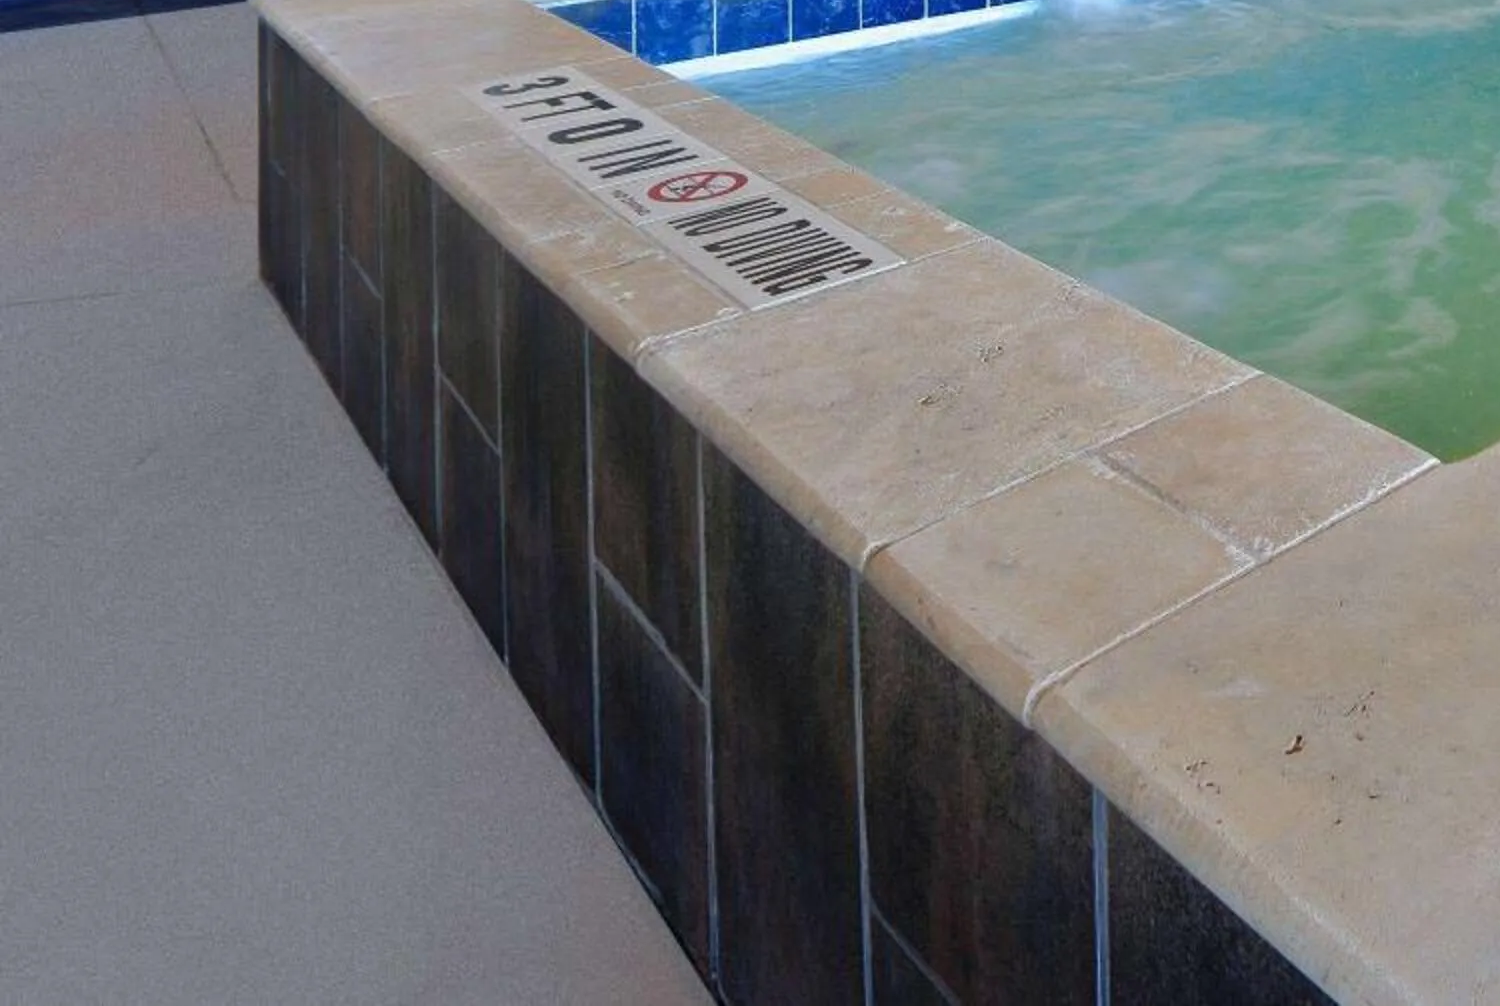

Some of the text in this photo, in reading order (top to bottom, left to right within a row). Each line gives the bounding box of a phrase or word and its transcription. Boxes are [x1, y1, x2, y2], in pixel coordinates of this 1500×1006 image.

[483, 76, 569, 95] 3
[503, 91, 618, 122] FT
[578, 139, 700, 179] IN
[667, 197, 788, 236] NO
[702, 218, 873, 296] DIVING
